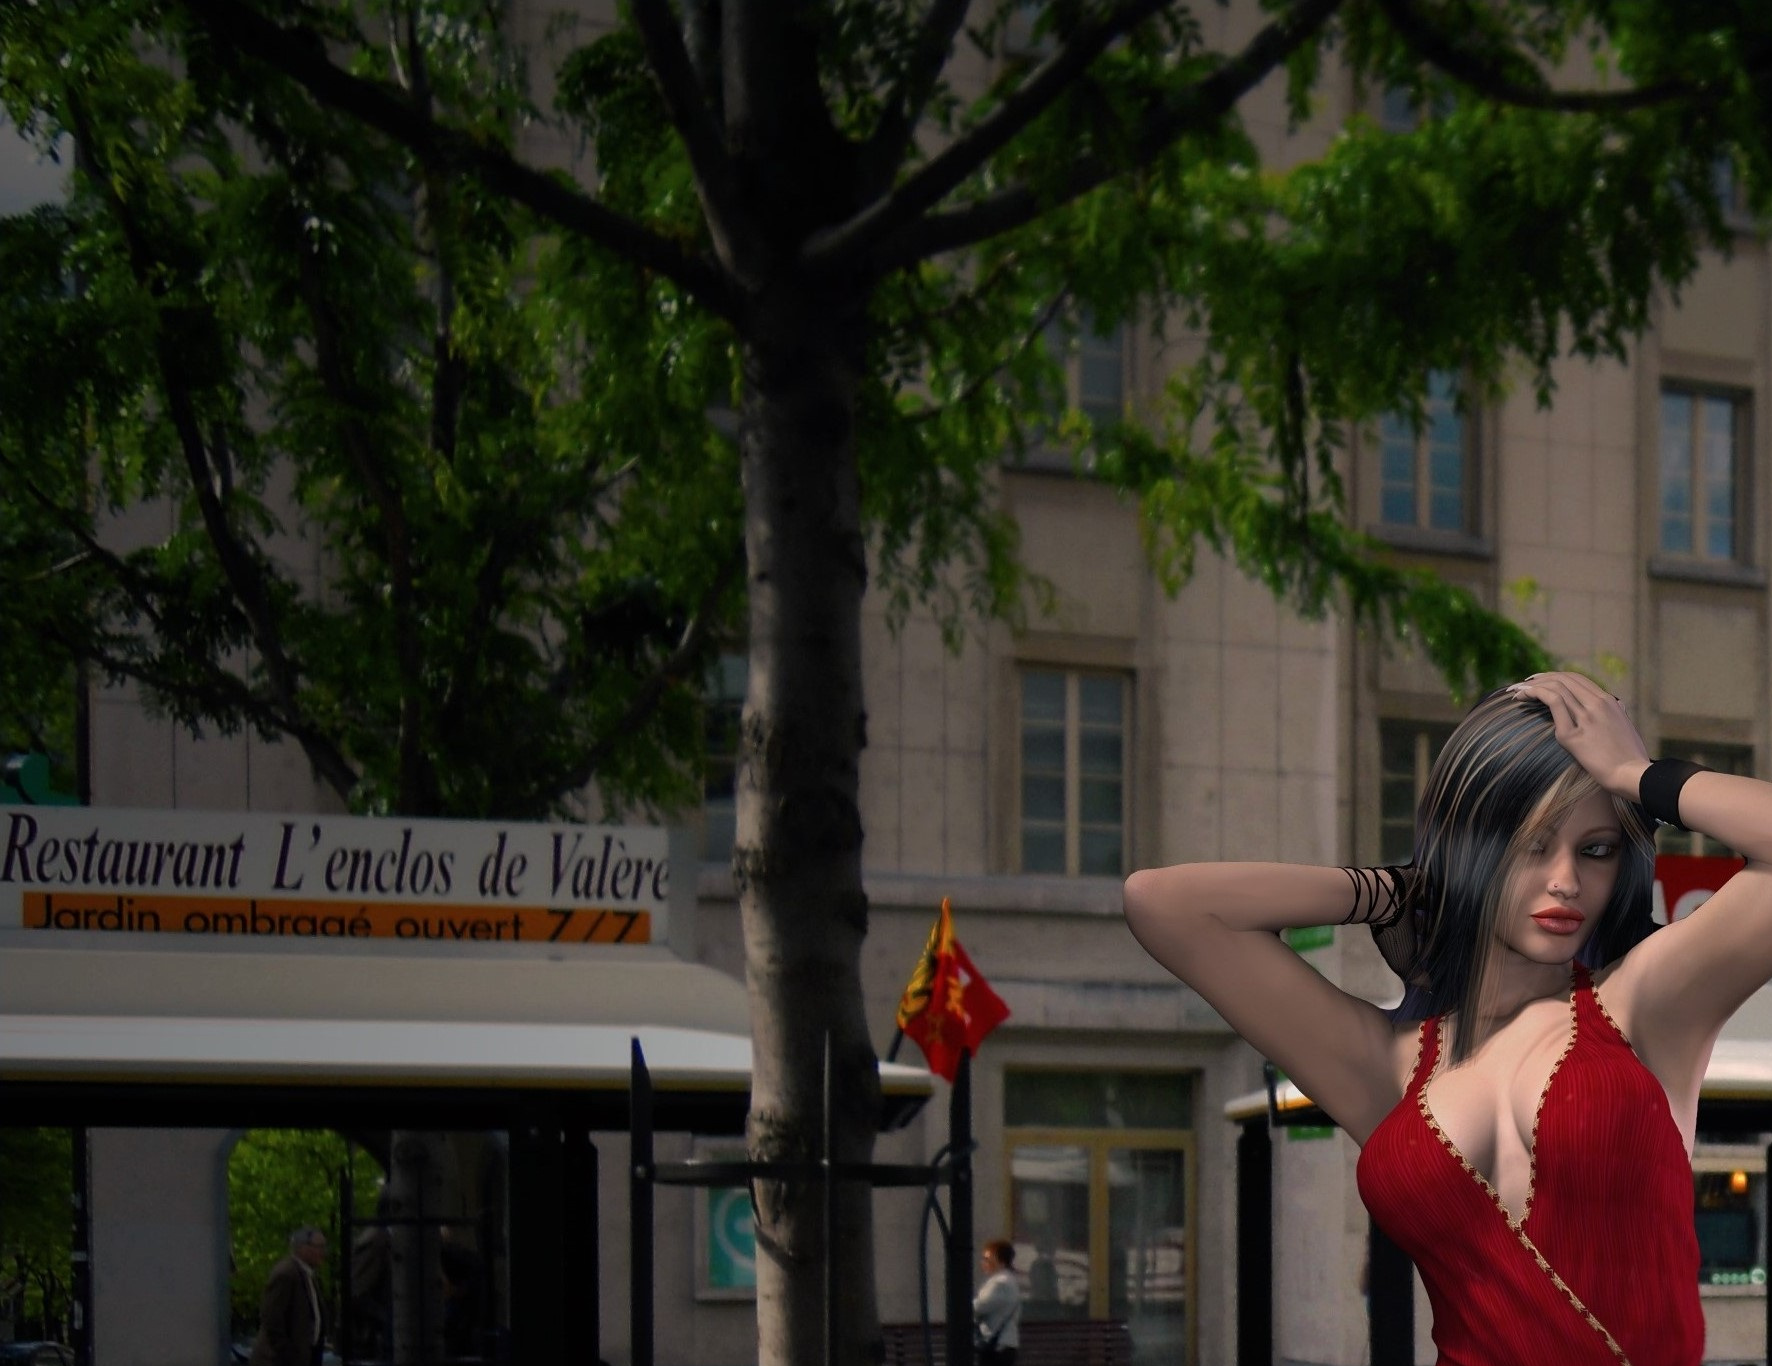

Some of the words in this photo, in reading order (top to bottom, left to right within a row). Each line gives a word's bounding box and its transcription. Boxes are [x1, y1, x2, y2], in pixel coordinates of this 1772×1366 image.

[0, 812, 245, 889] Restaurant
[272, 821, 455, 894] L'enclos
[478, 831, 528, 898] de
[551, 831, 670, 901] Valère
[33, 894, 160, 932] Jardin
[394, 911, 523, 941] ouvert
